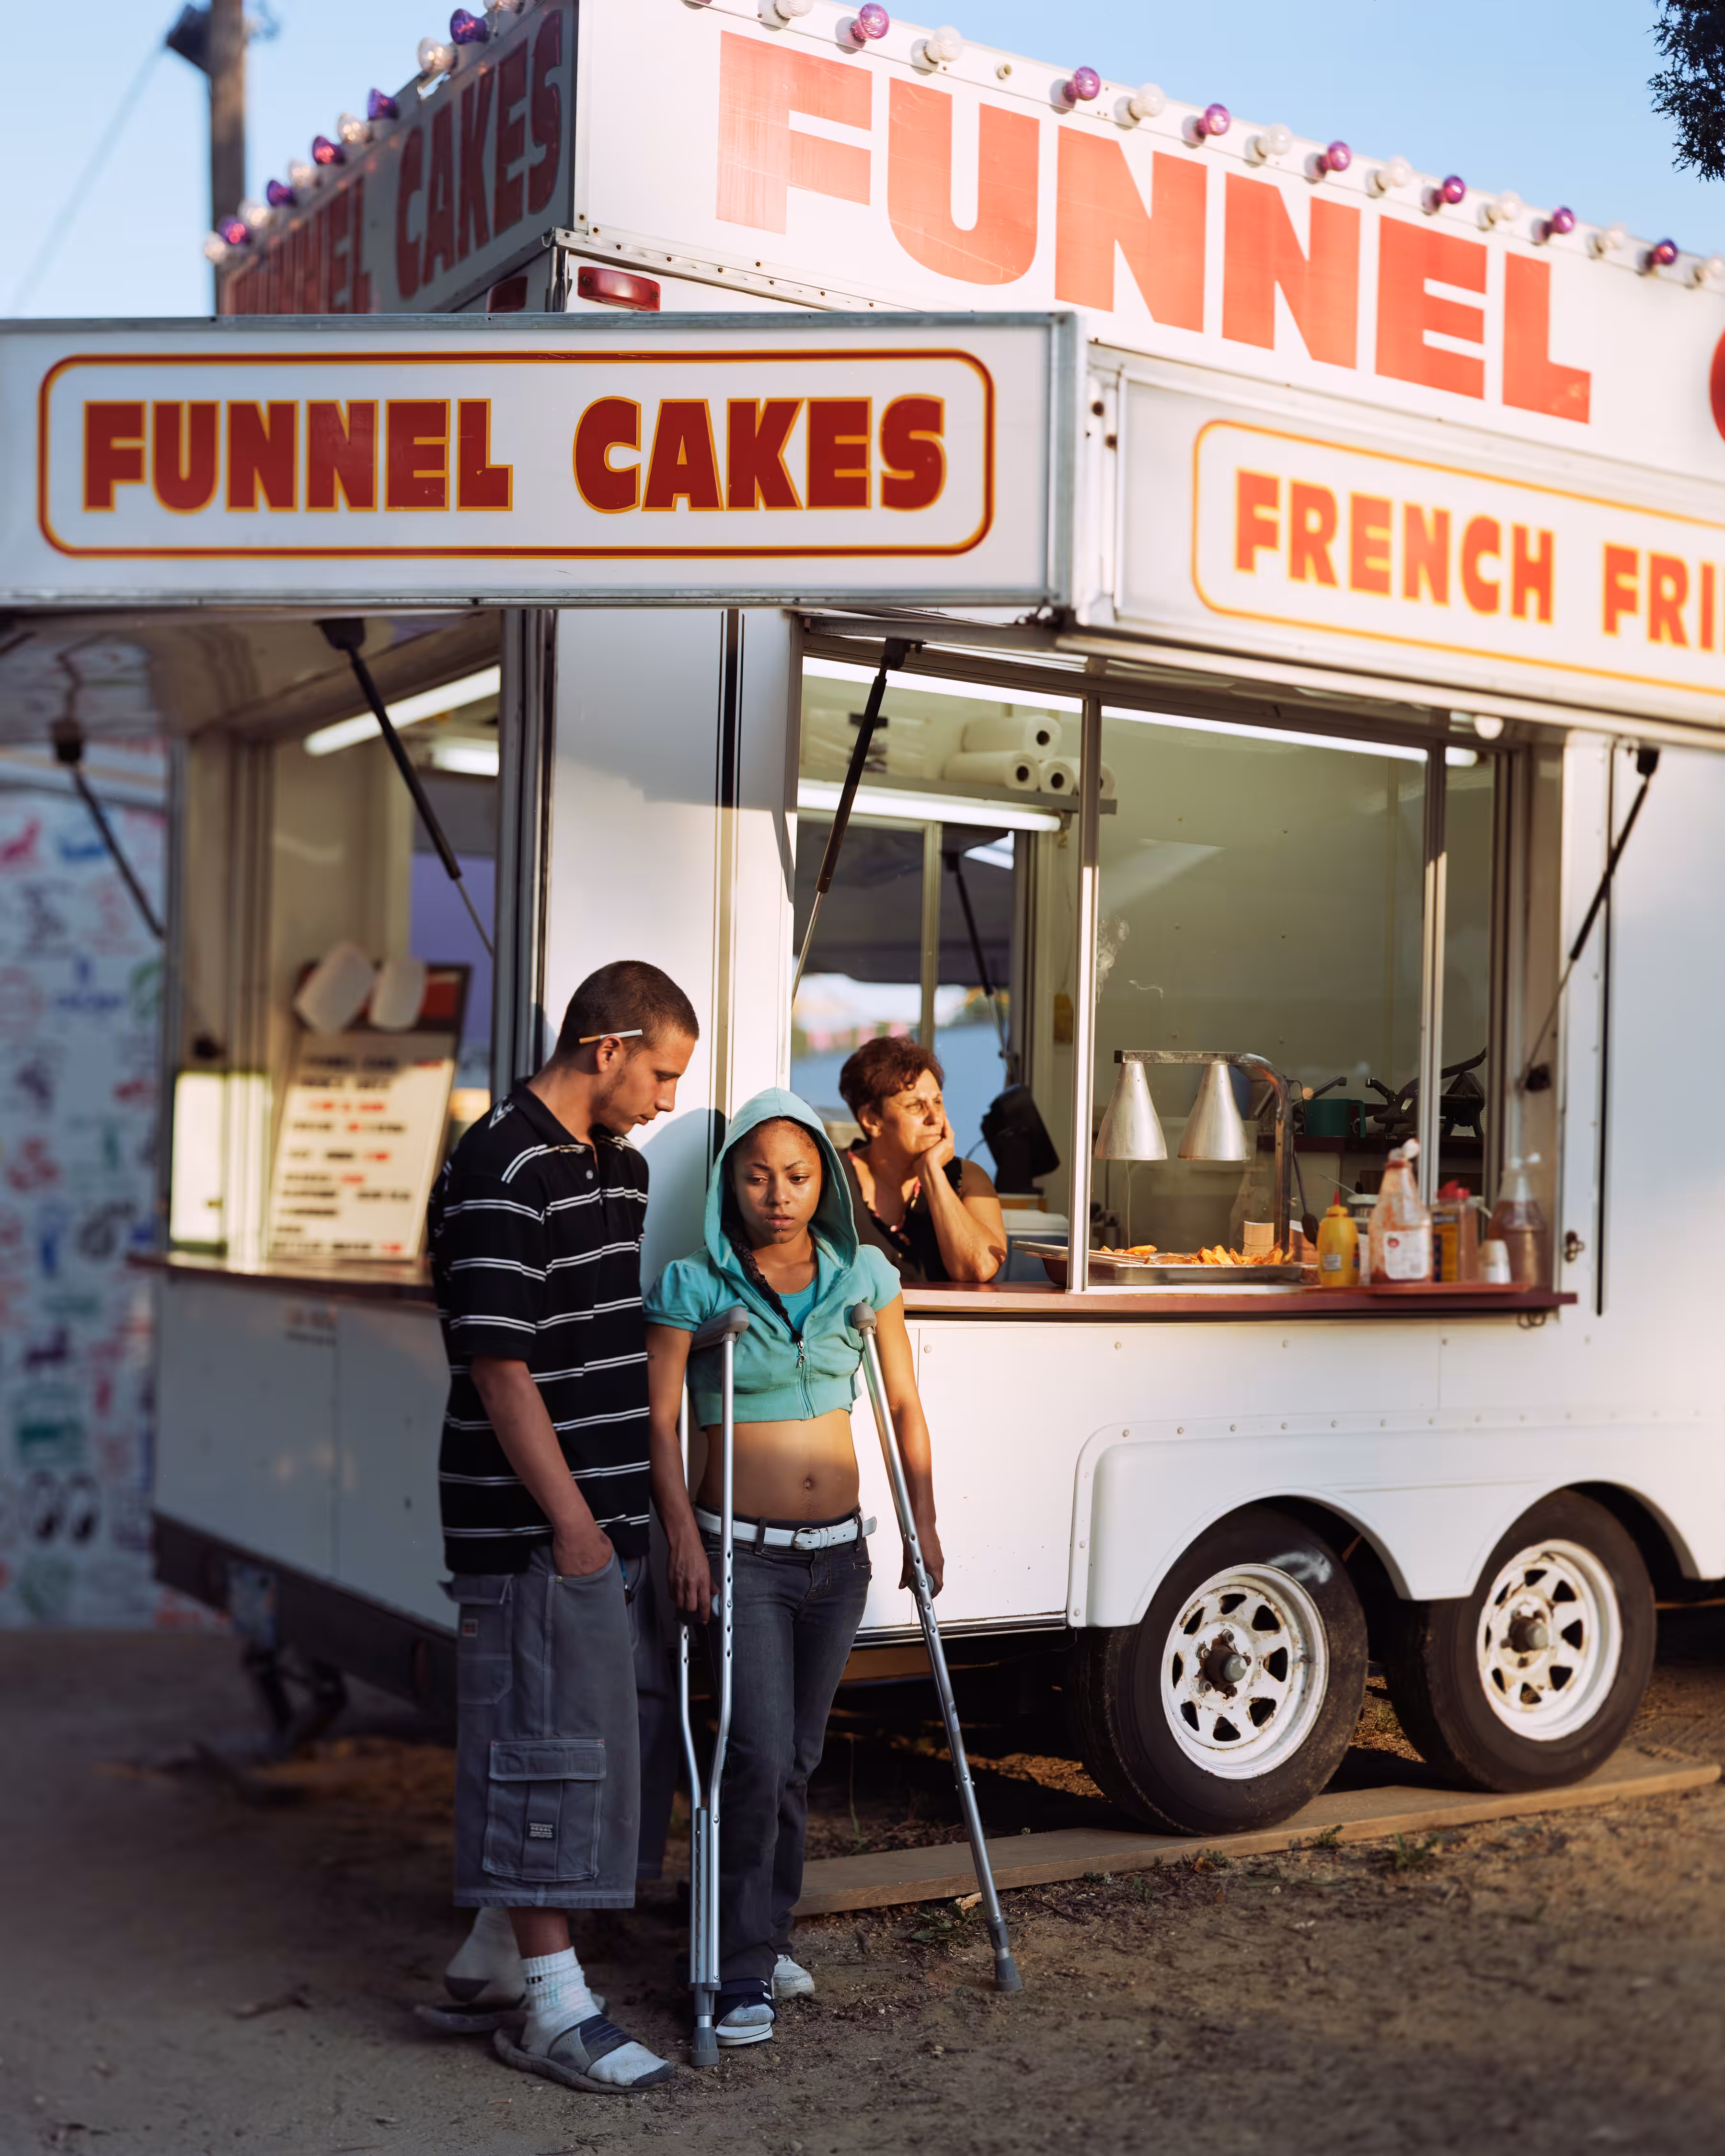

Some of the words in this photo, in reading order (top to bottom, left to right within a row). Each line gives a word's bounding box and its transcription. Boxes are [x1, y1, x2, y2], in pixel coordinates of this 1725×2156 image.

[395, 9, 564, 300] CAKES
[716, 30, 1591, 425] FUNNEL
[82, 399, 513, 514] FUNNEL
[573, 394, 945, 514] CAKES
[1234, 466, 1554, 624] FRENCH
[1602, 540, 1725, 653] FRI
